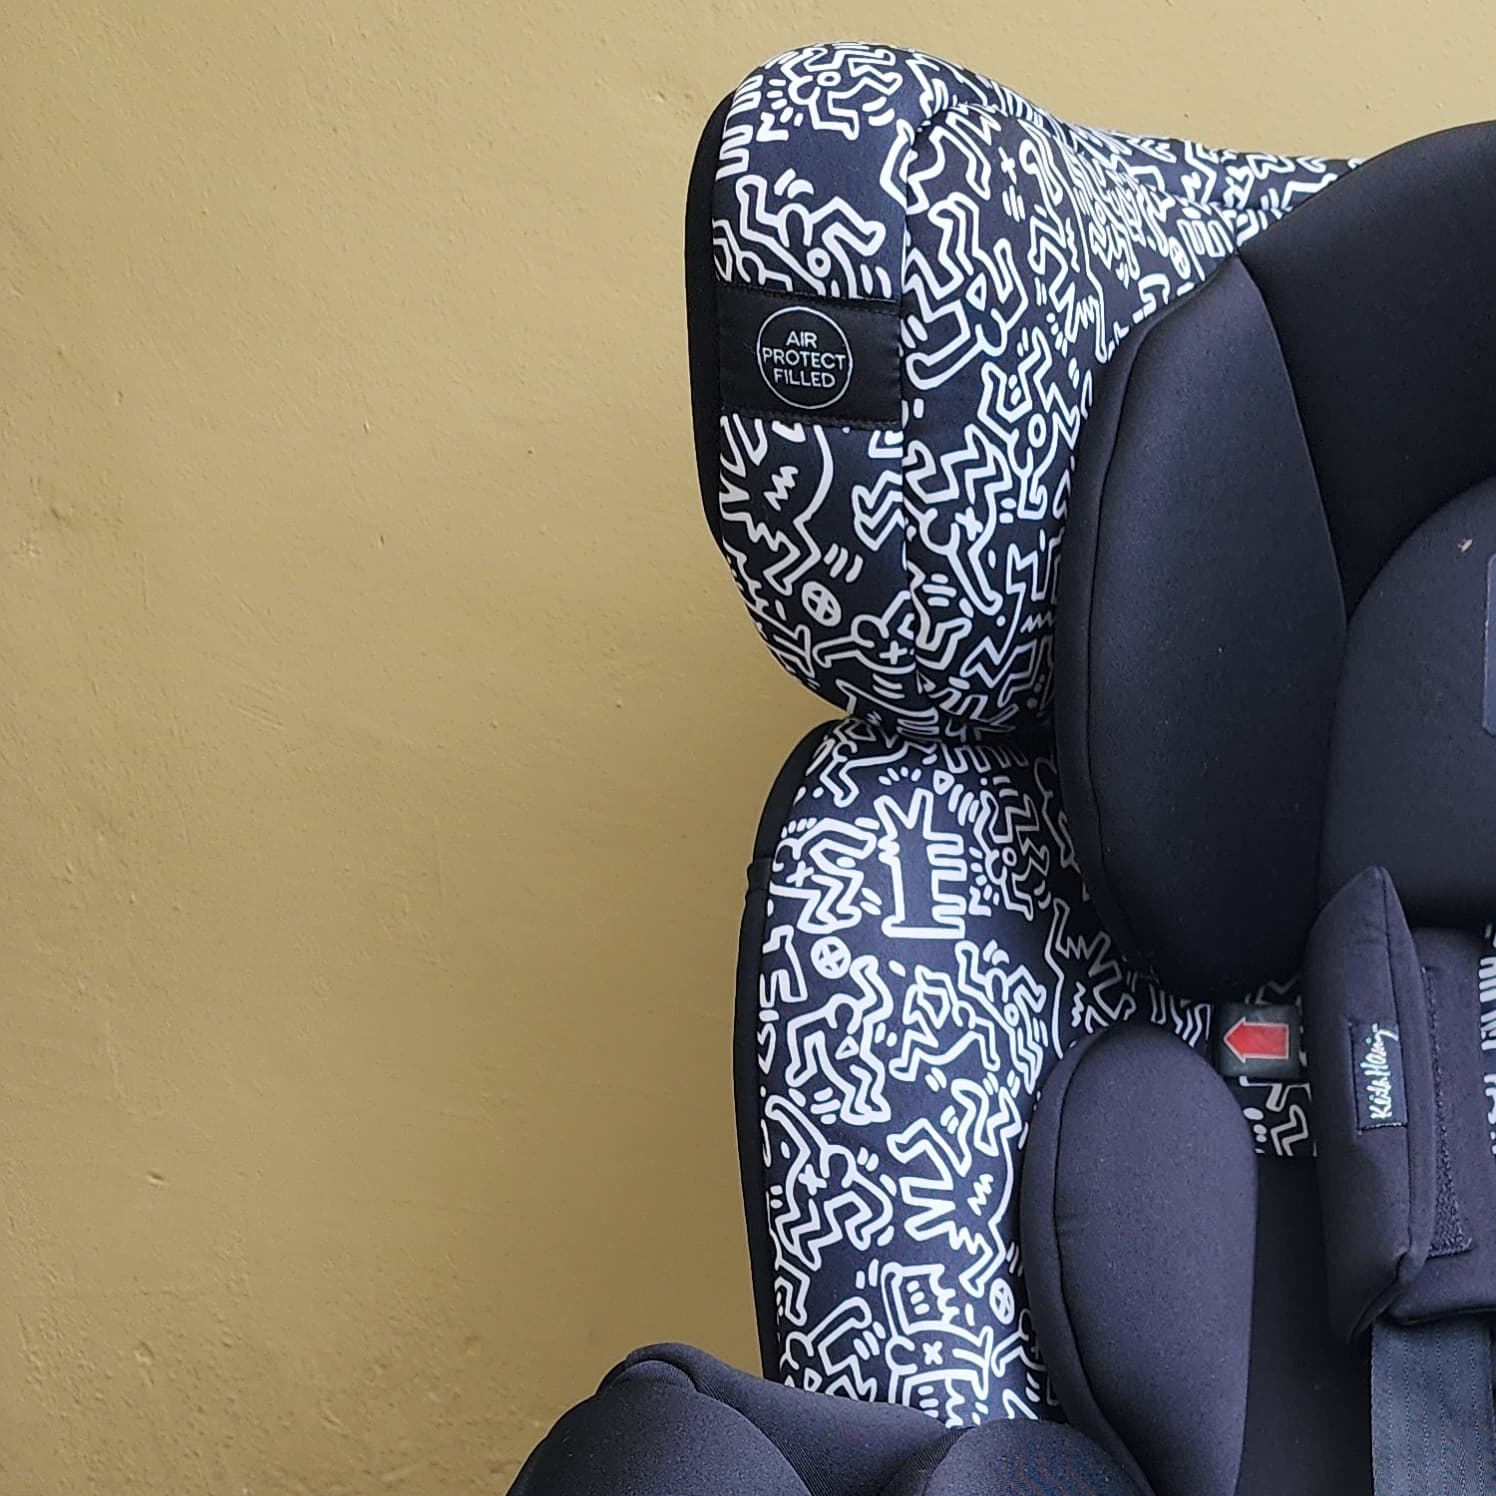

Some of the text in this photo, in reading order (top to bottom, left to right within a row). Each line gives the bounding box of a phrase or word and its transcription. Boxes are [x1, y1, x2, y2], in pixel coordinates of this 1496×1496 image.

[785, 331, 818, 348] AIR
[762, 347, 846, 370] PROTECT
[774, 368, 836, 388] FILLED
